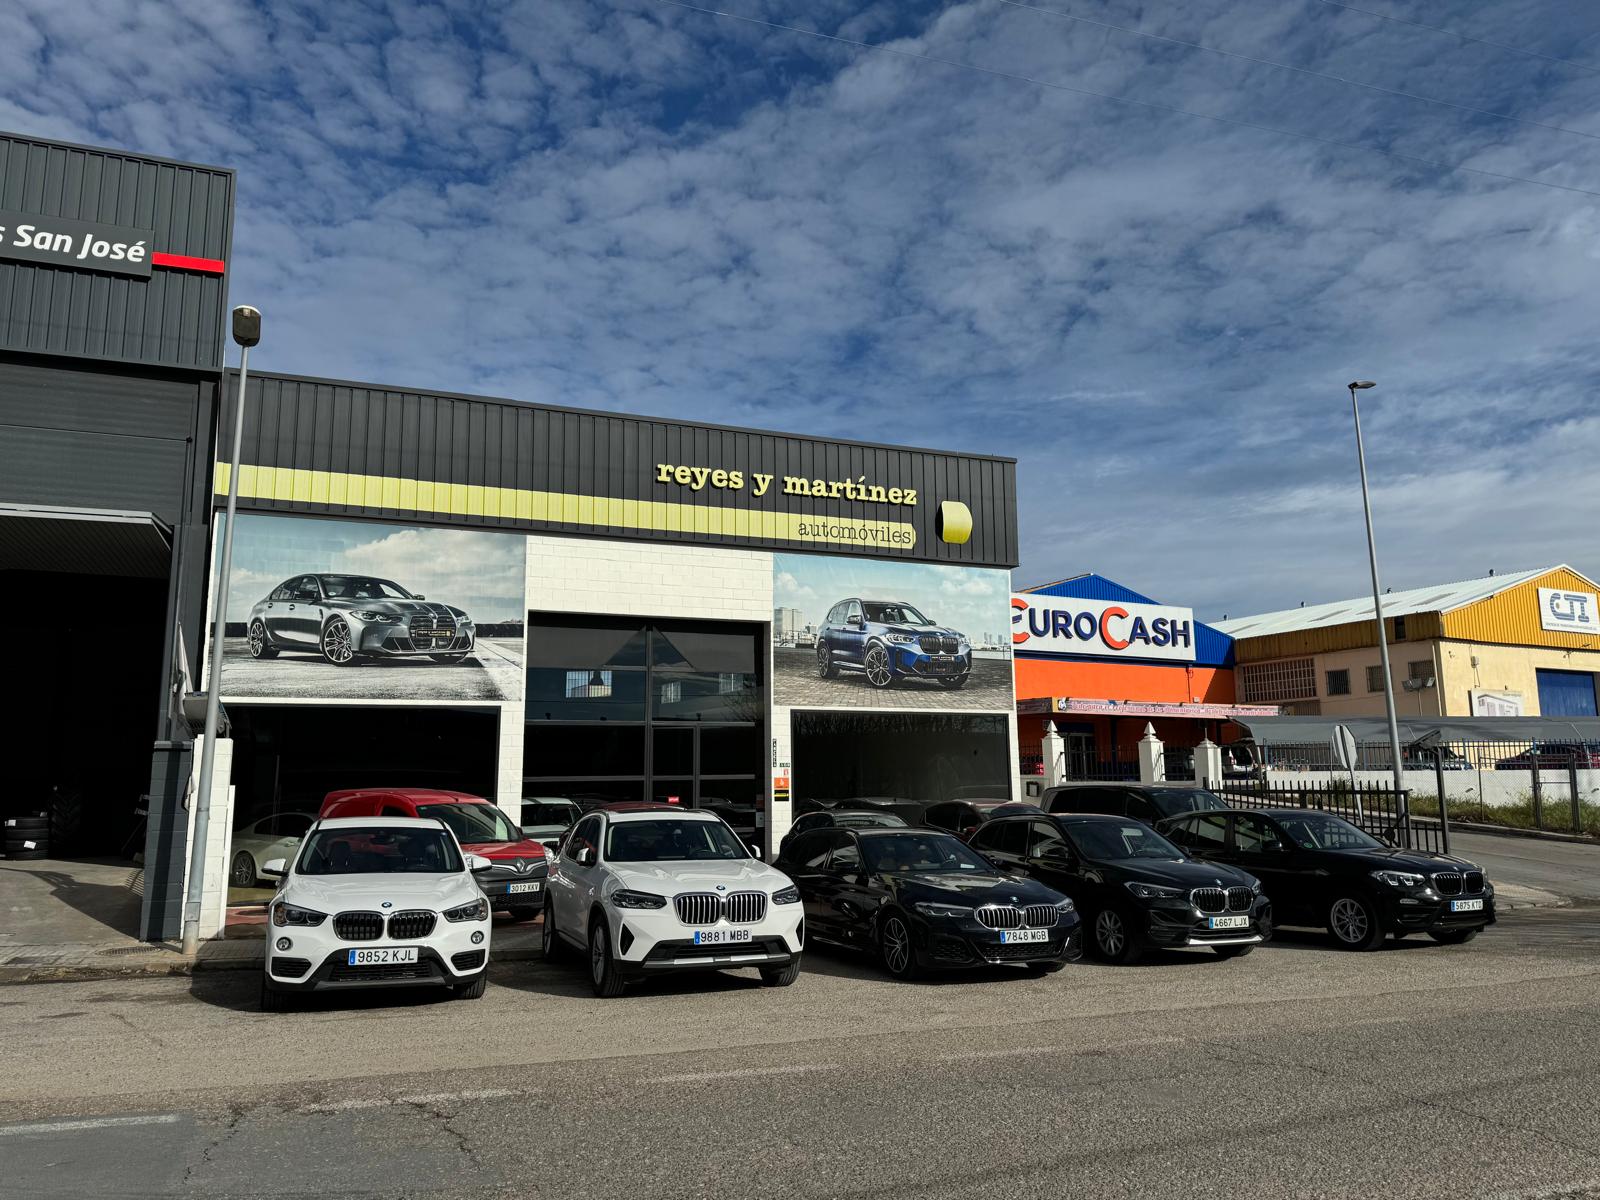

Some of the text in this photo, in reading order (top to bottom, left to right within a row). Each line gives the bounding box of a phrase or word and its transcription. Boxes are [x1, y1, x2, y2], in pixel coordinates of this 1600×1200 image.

[13, 224, 73, 253] San
[76, 234, 147, 263] José
[657, 463, 917, 505] reyes y martínez
[798, 520, 911, 544] automóviles
[1214, 917, 1232, 927] 4667
[700, 929, 749, 942] 9881 MBB
[1006, 930, 1046, 942] 7848 MGB
[357, 949, 415, 962] 9852 KJL
